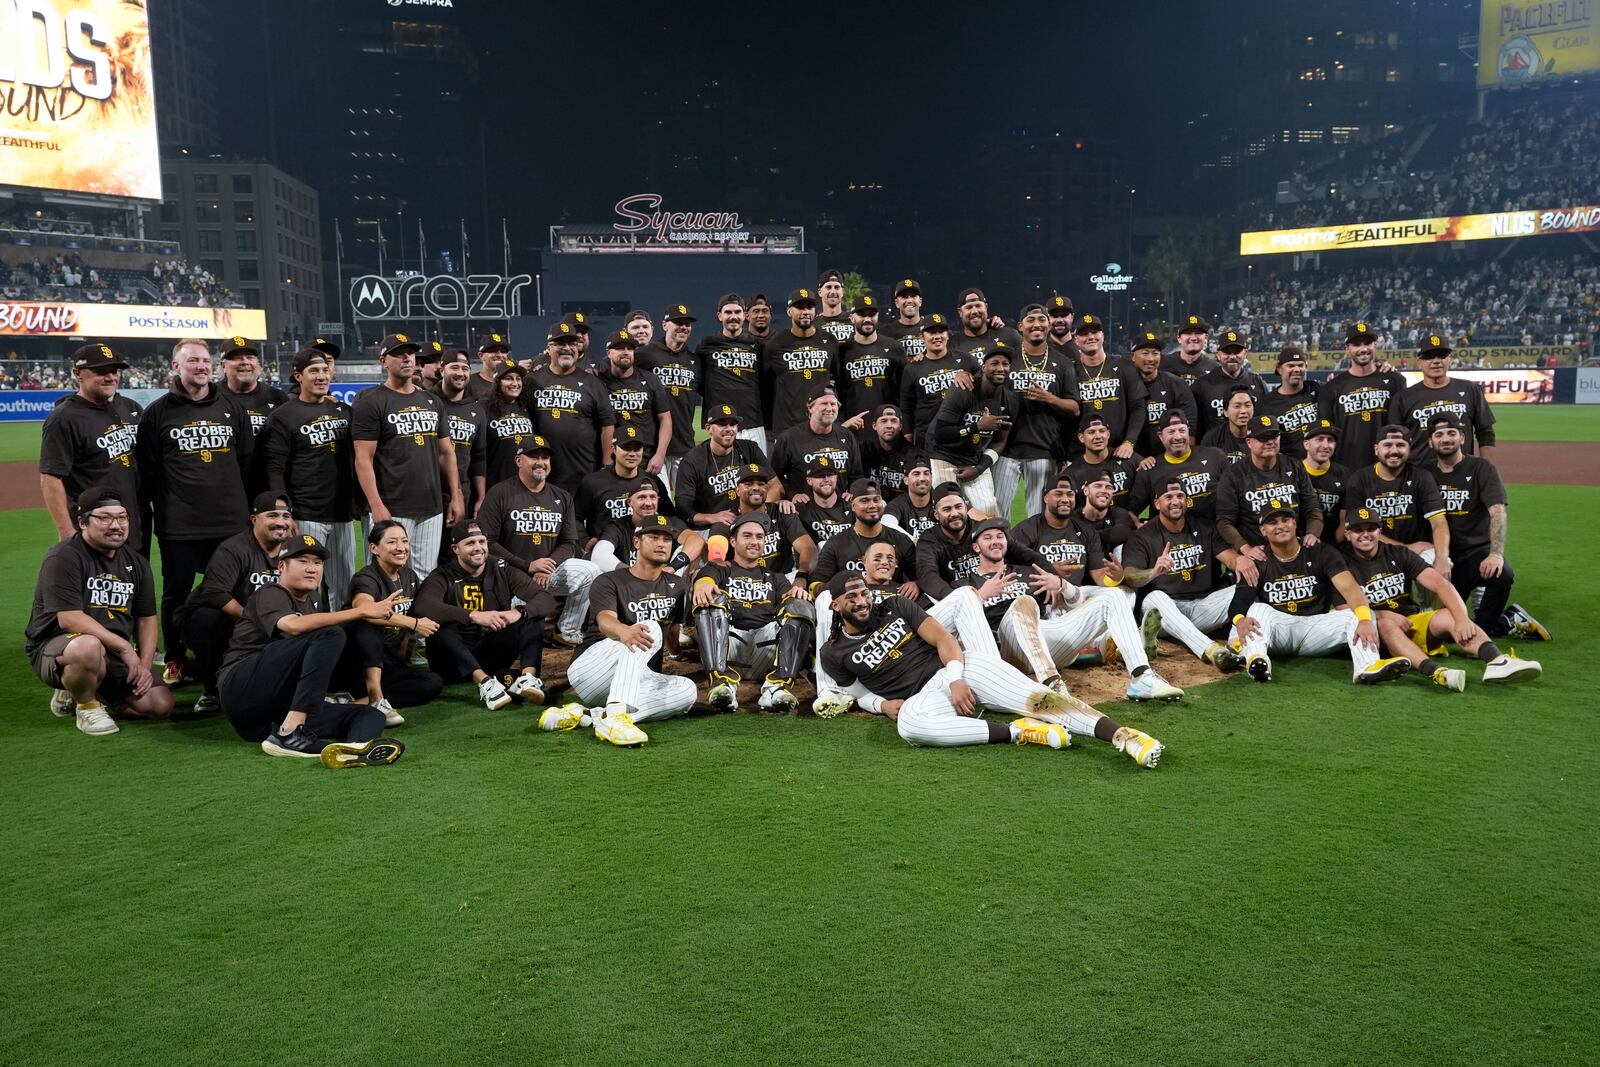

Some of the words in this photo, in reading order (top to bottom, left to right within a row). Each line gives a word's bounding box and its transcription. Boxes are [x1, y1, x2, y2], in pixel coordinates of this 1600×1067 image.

[0, 85, 85, 121] UND
[3, 137, 62, 151] FAITHFUL
[613, 193, 744, 241] Sycuan
[1490, 212, 1535, 236] NLDS
[1540, 206, 1600, 230] BOUND
[670, 232, 706, 241] CASINO
[714, 232, 750, 241] RESORT
[1354, 222, 1437, 242] FAITHFUL
[1090, 274, 1133, 284] Gallagher
[1096, 282, 1127, 292] Square
[399, 274, 532, 318] razr
[129, 316, 208, 329] POSTSEASON
[825, 325, 855, 333] TOBER
[900, 340, 924, 348] TOBE
[712, 352, 758, 363] OCTOBER
[783, 351, 829, 361] OCTOBER
[906, 347, 926, 356] ADY
[1490, 346, 1574, 358] STANDARD
[718, 358, 756, 369] READY
[789, 359, 826, 370] READY
[846, 358, 890, 370] OCTOBER
[653, 366, 695, 380] OCTOBER
[851, 366, 887, 378] READY
[919, 369, 963, 386] OCTOB
[1009, 371, 1056, 383] OCTOBER
[659, 375, 692, 387] READY
[924, 380, 955, 394] REA
[1477, 380, 1535, 393] HFUL
[534, 389, 582, 402] OCTOBER
[609, 392, 648, 402] CTOBER
[1080, 387, 1117, 401] READY
[1339, 392, 1390, 405] OCTOBER
[0, 398, 55, 412] outhwe
[537, 398, 577, 408] READY
[1345, 399, 1387, 413] READY
[388, 411, 438, 424] OCTOBER
[1413, 404, 1467, 420] OCTOBER
[449, 420, 476, 434] OBER
[490, 418, 532, 429] OCTOBER
[1284, 411, 1316, 431] READ
[170, 425, 233, 440] OCTOBER
[396, 421, 437, 436] READY
[450, 429, 473, 441] ADY
[497, 424, 533, 437] READY
[178, 436, 230, 451] READY
[309, 428, 345, 445] REA
[708, 468, 739, 485] OCTOB
[871, 468, 905, 481] OBER
[1182, 472, 1211, 486] OBER
[714, 476, 740, 494] REA
[1246, 485, 1297, 501] OCTOBER
[1440, 490, 1470, 500] OBER
[1252, 494, 1292, 512] REDY
[1365, 495, 1413, 508] OCTOBER
[511, 509, 562, 523] OCTOBER
[611, 508, 633, 518] REA
[516, 520, 558, 533] READY
[1040, 544, 1087, 555] OCTOBER
[1168, 545, 1204, 560] CTOBER
[1264, 576, 1318, 592] OCTOBER
[729, 586, 769, 601] READY
[1268, 585, 1314, 604] READY
[1365, 583, 1406, 604] READY
[636, 608, 673, 622] READ
[863, 625, 907, 669] READY
